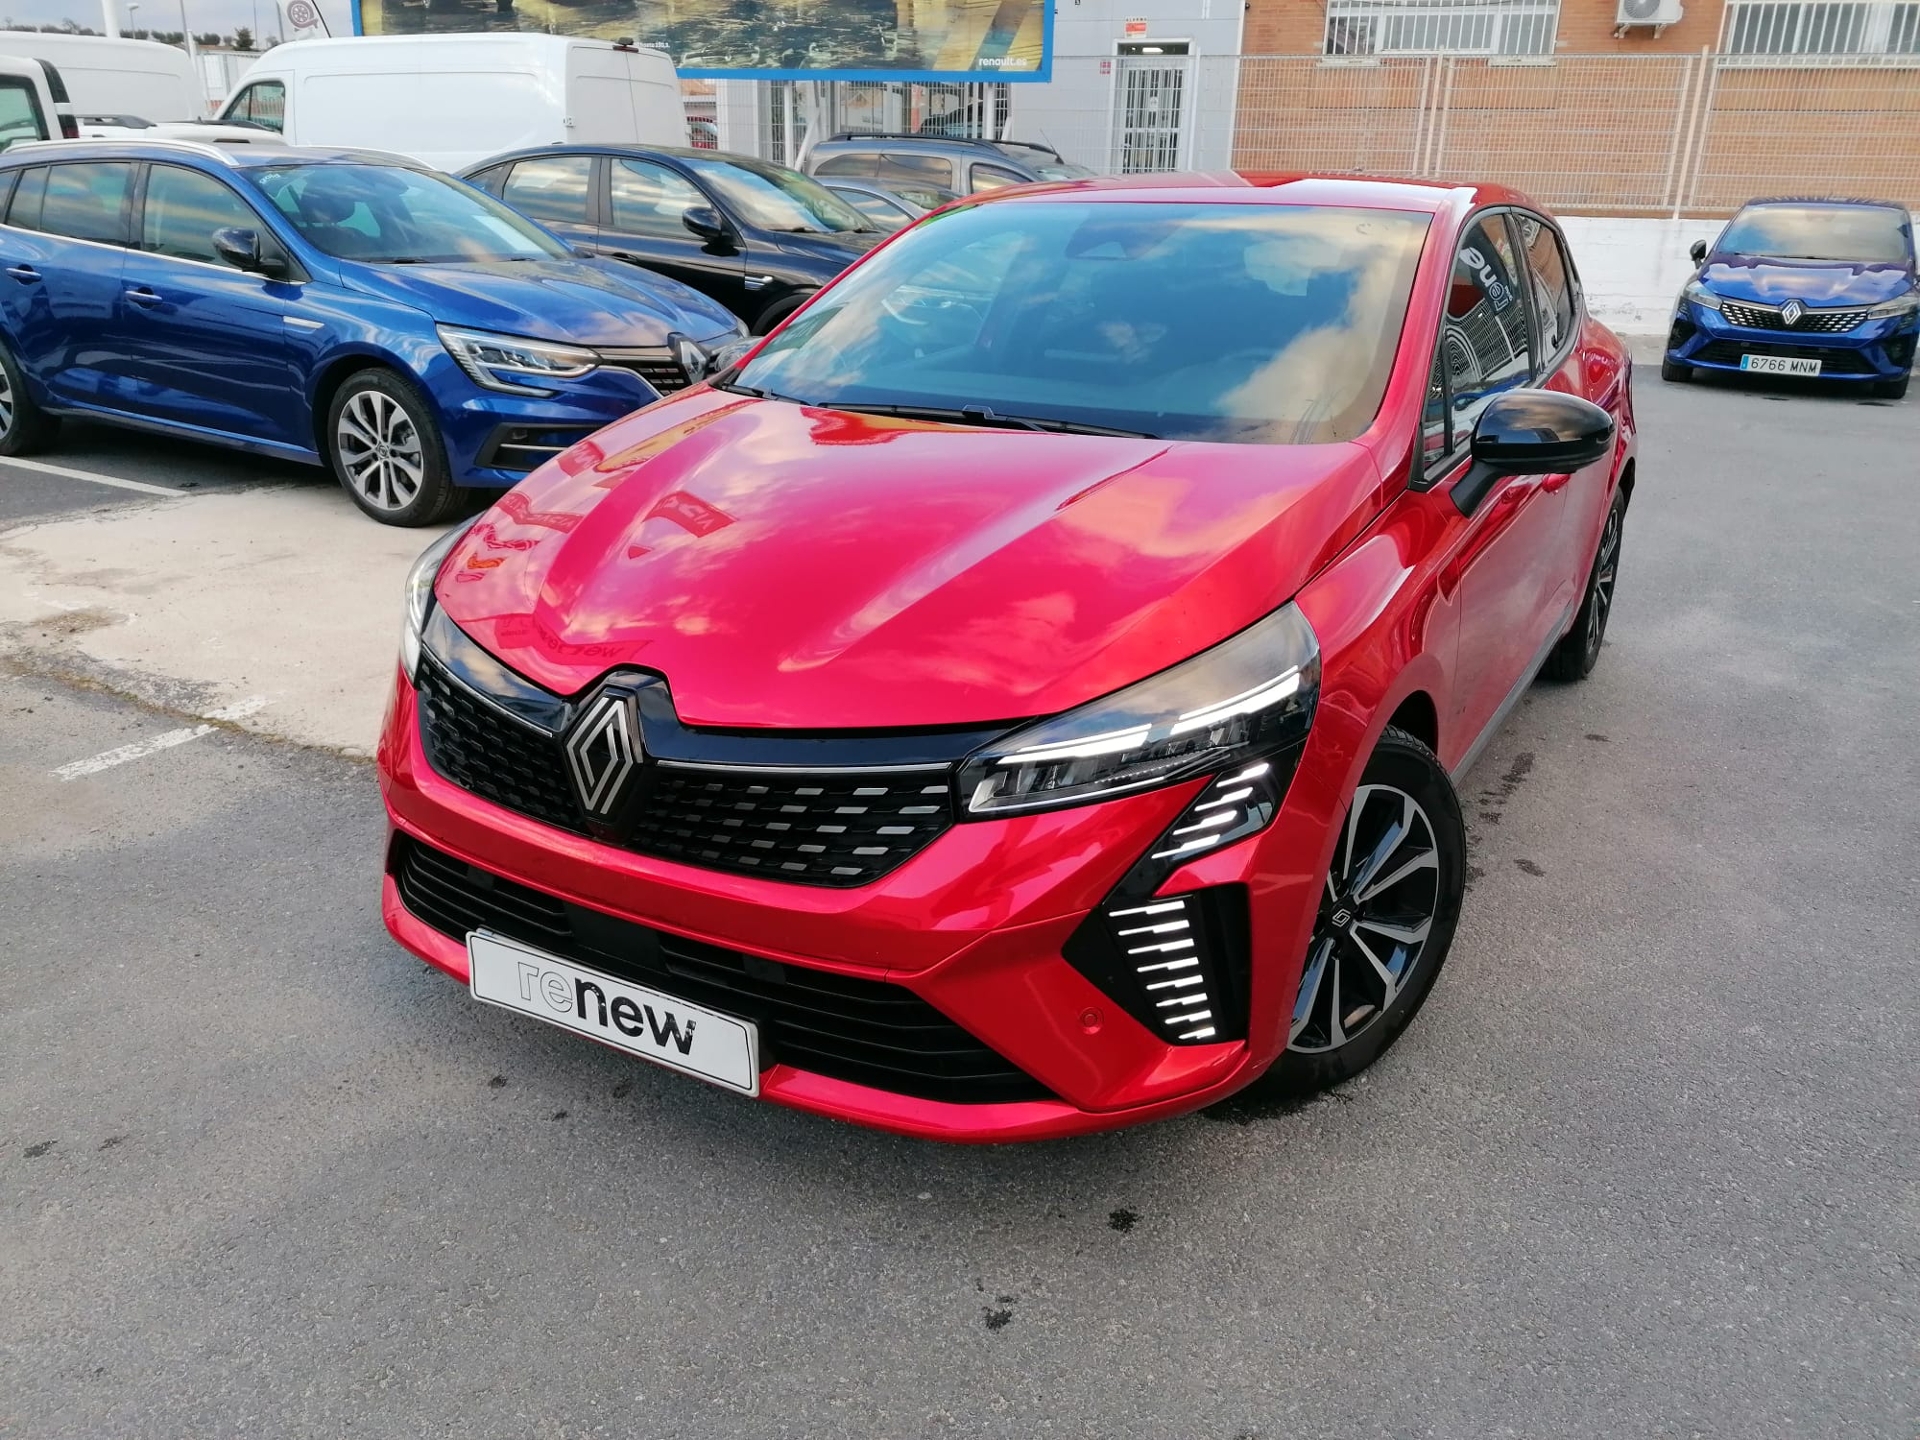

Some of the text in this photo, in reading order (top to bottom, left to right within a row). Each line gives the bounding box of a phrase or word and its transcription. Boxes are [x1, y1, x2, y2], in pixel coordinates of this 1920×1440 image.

[979, 57, 1027, 66] renault.es
[1751, 358, 1817, 373] 6766 MNM
[517, 961, 696, 1055] renew
